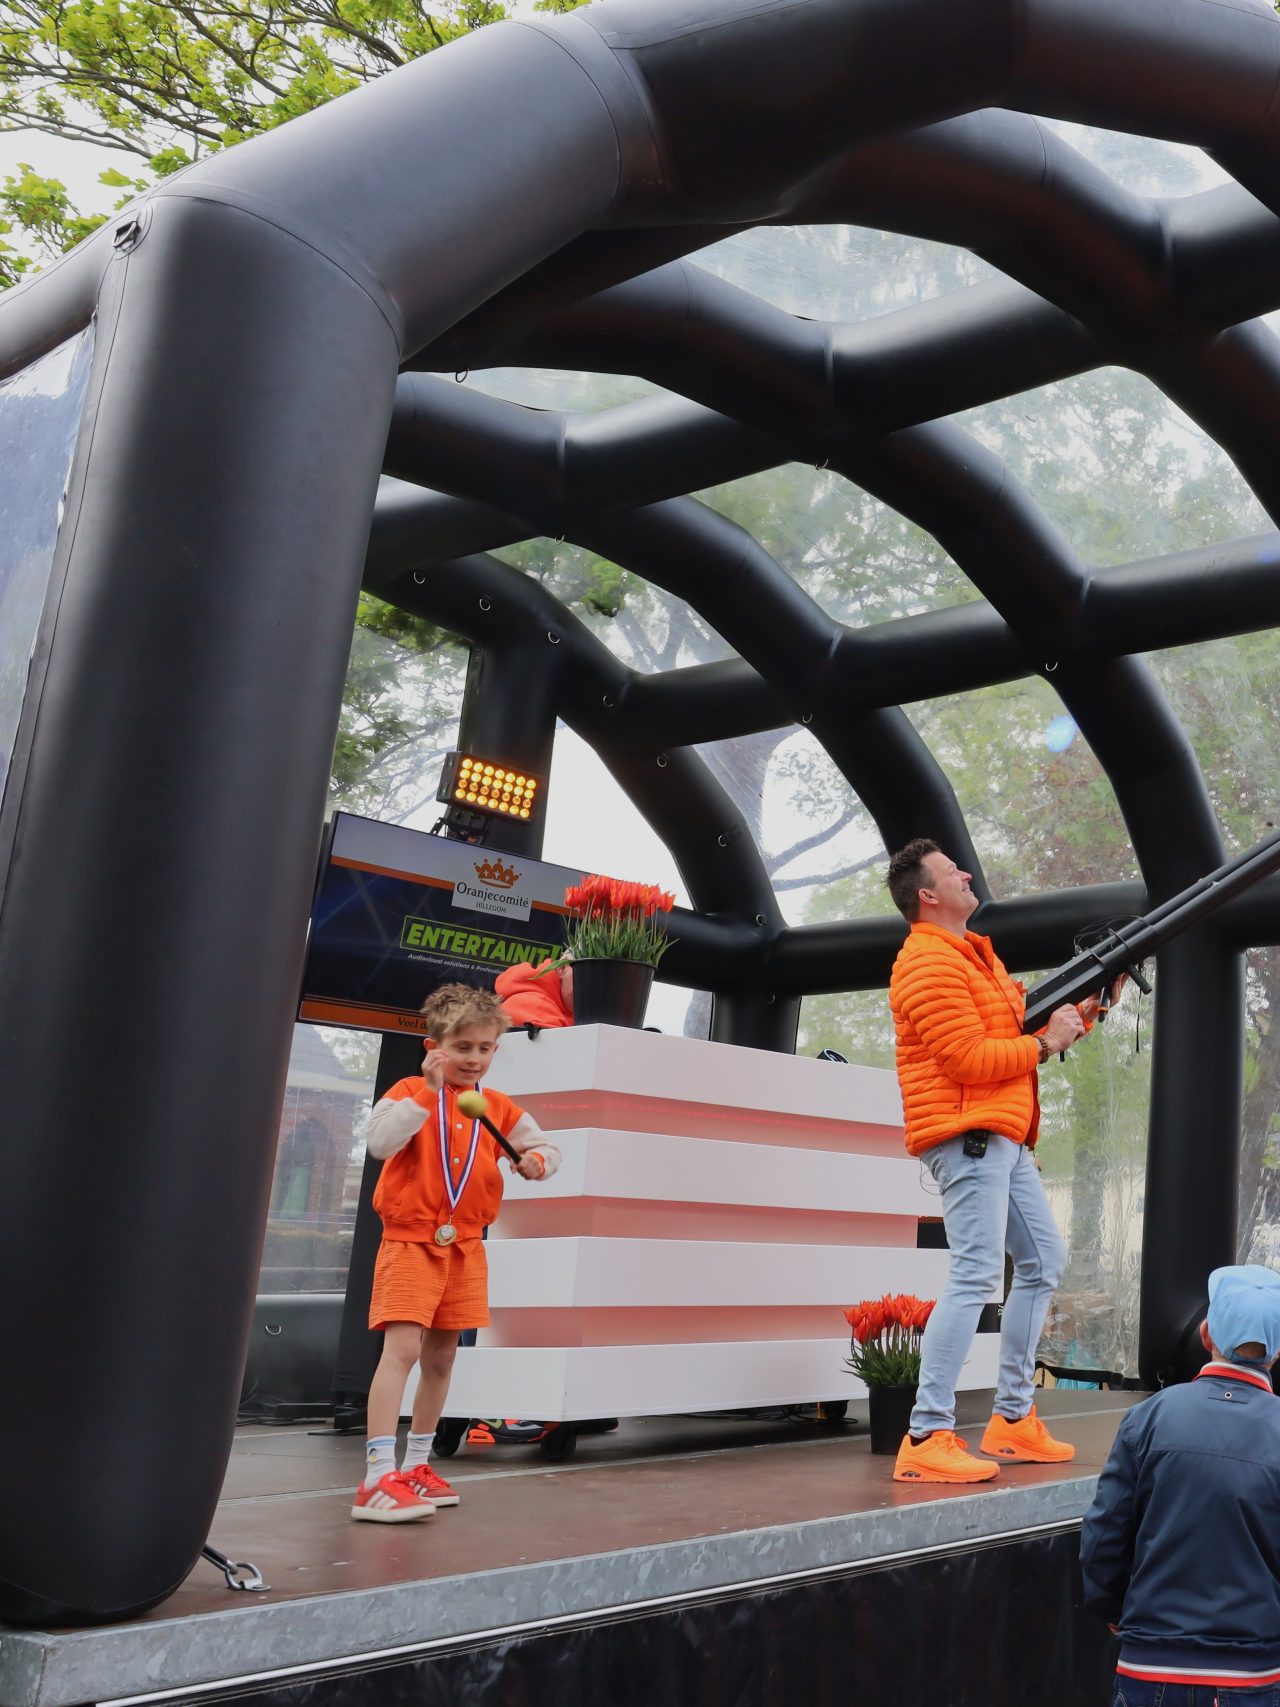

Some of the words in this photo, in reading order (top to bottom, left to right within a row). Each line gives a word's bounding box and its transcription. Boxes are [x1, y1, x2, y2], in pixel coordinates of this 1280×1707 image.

[456, 881, 529, 908] Oranjecomité
[475, 901, 507, 914] HILLEGOM
[443, 959, 470, 970] solutions
[398, 1016, 418, 1029] Veel
